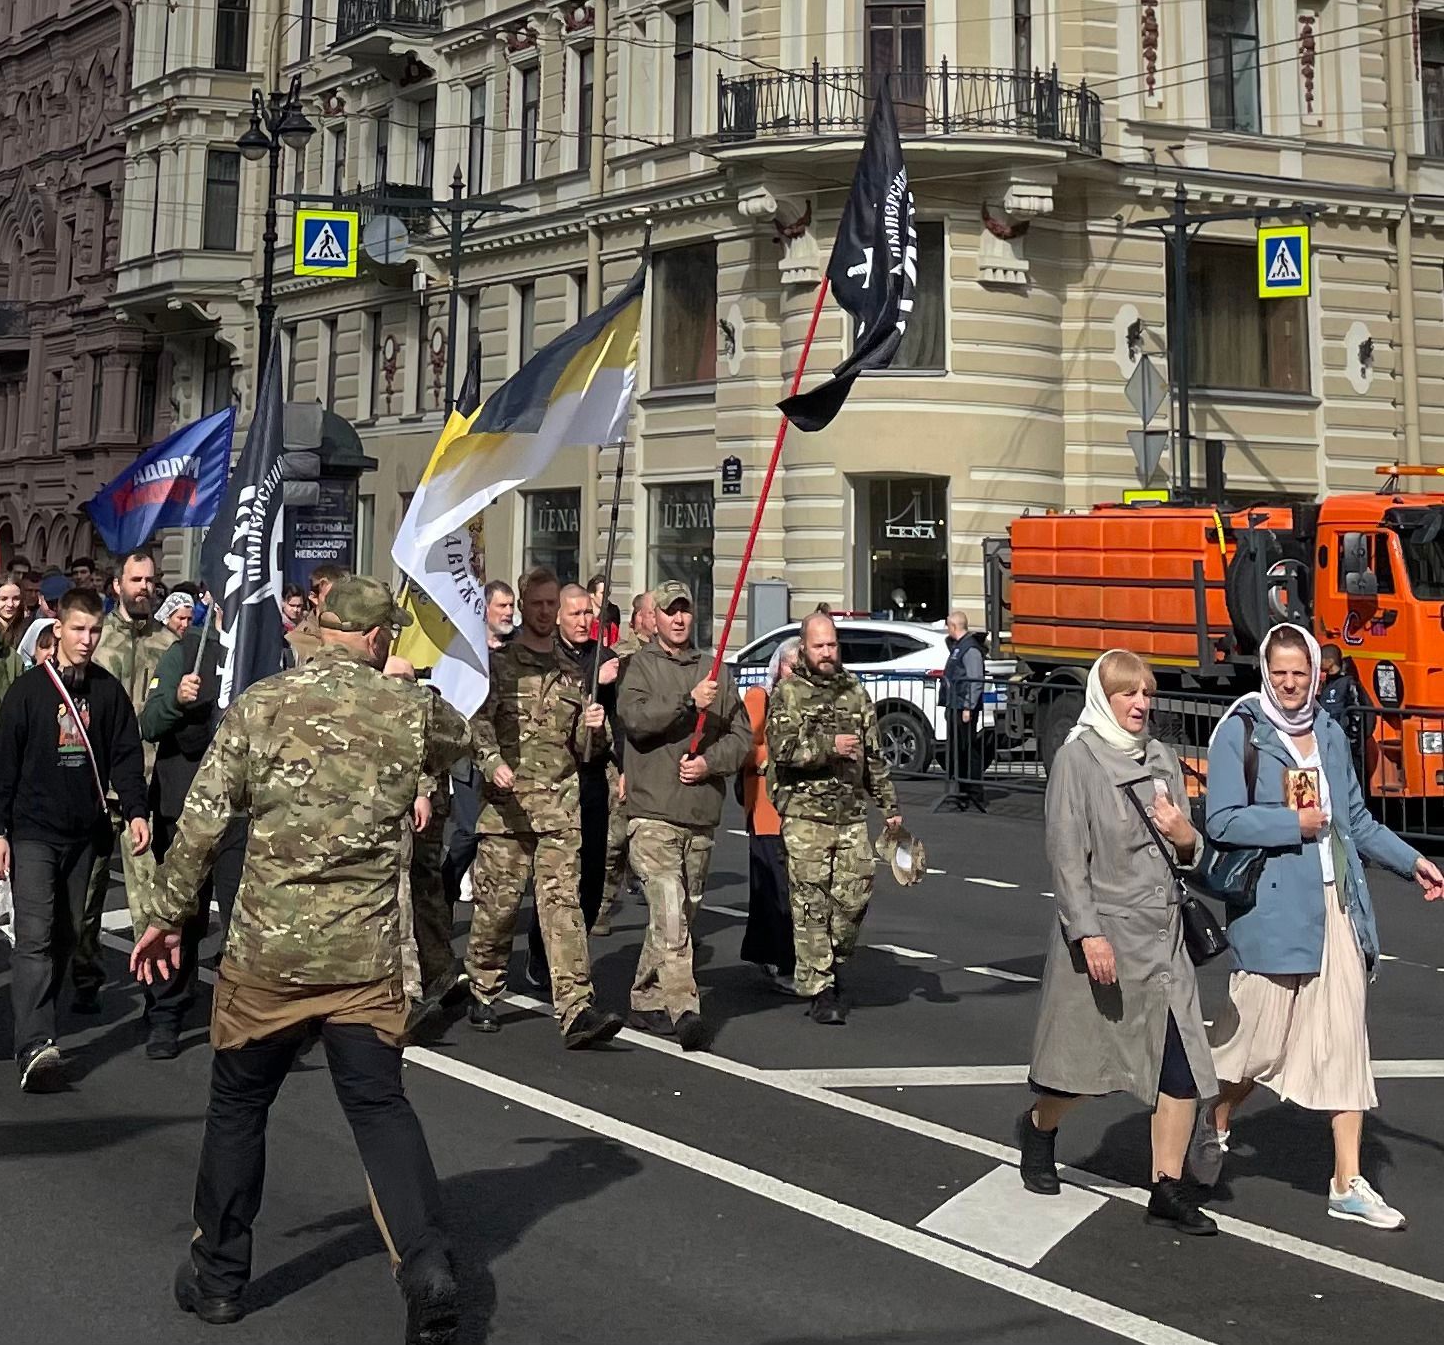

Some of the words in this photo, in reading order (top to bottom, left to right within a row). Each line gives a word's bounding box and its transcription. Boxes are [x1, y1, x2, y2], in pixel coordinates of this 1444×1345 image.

[539, 509, 580, 532] LENA
[664, 503, 711, 529] LENA
[885, 525, 936, 539] LENA
[295, 549, 338, 559] НЕВСКОГО
